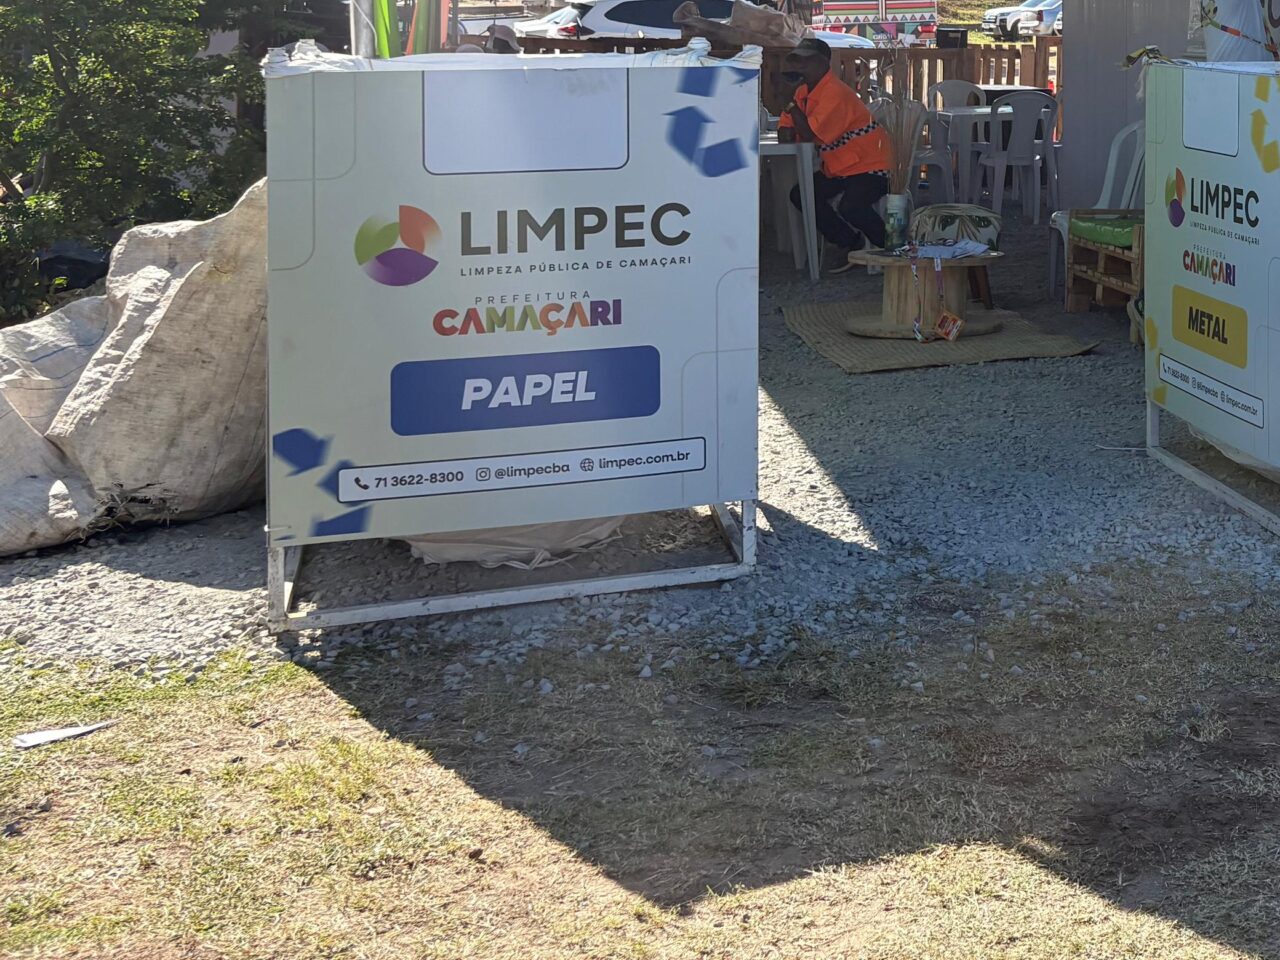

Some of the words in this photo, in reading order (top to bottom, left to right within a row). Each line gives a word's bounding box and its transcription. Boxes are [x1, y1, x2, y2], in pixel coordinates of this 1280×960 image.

[1190, 177, 1260, 228] LIMPEC
[460, 202, 692, 256] LIMPEC
[1234, 232, 1260, 246] CAMAÇARI
[460, 265, 522, 277] LIMPEZA
[529, 262, 590, 273] PÚBLICA
[596, 260, 613, 270] DE
[619, 256, 692, 268] CAMAÇARI
[1183, 249, 1236, 287] CAMAÇARI
[475, 290, 591, 305] PREFEITURA
[432, 298, 622, 336] CAMAÇARI
[1188, 306, 1228, 345] METAL
[461, 370, 597, 410] PAPEL
[374, 477, 388, 489] 71
[391, 470, 465, 487] 3622-8300
[494, 462, 571, 479] @limpecba
[598, 450, 691, 470] limpec.com.br
